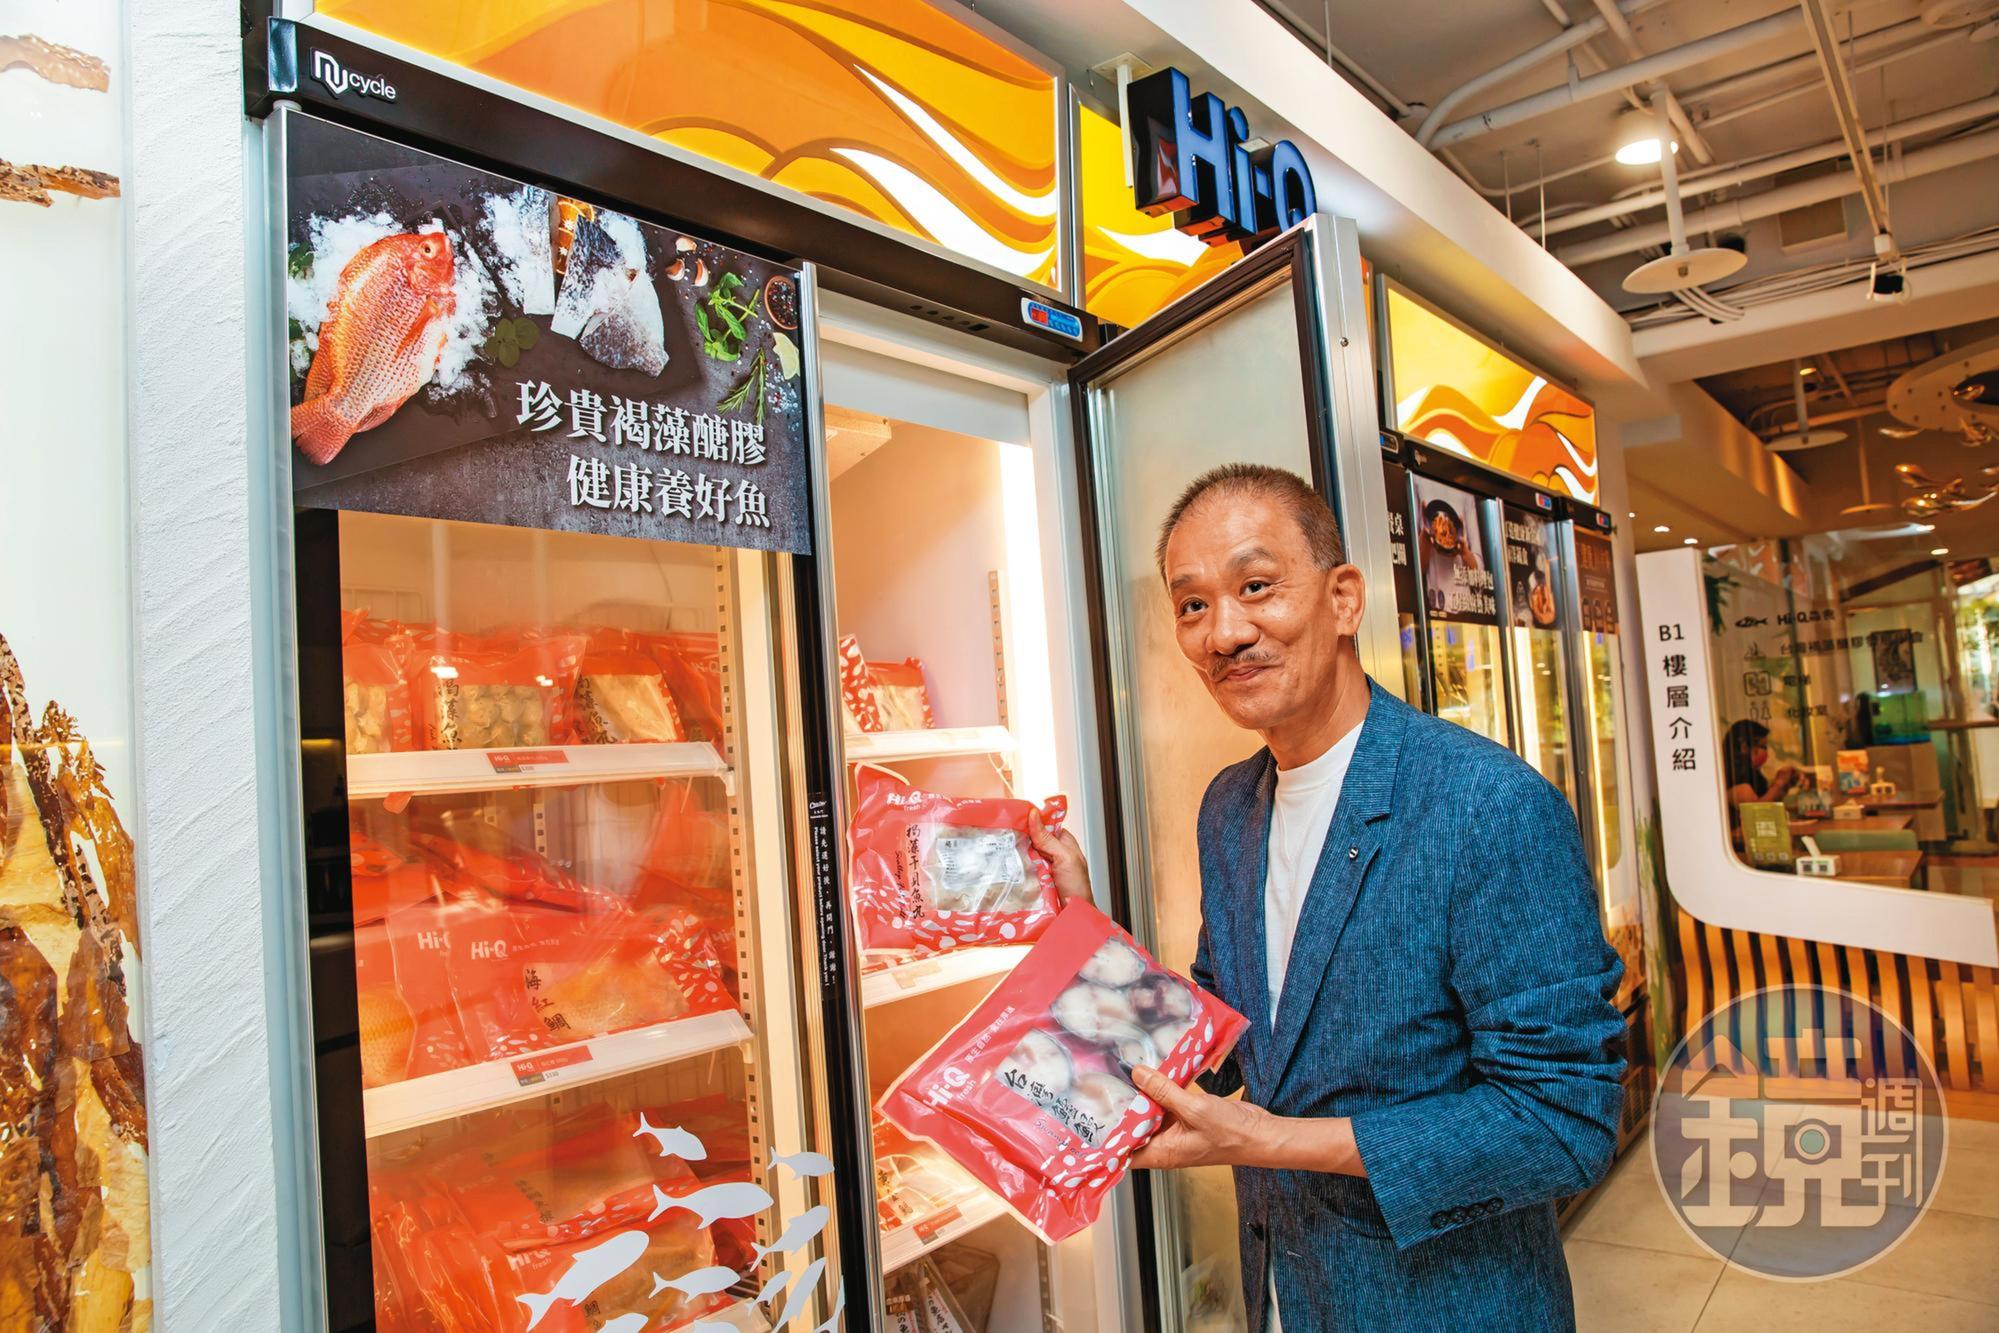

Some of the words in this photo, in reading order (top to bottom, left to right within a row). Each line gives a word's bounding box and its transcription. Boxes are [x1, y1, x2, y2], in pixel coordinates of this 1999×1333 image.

[1170, 67, 1317, 234] Hi-Q
[515, 379, 766, 464] 珍貴褐藻醣膠
[566, 454, 770, 528] 健康養好魚
[470, 939, 509, 960] Hi-Q
[525, 968, 572, 1031] 海紅鯛
[922, 1066, 971, 1107] Hi-Q
[957, 1079, 977, 1101] fresh
